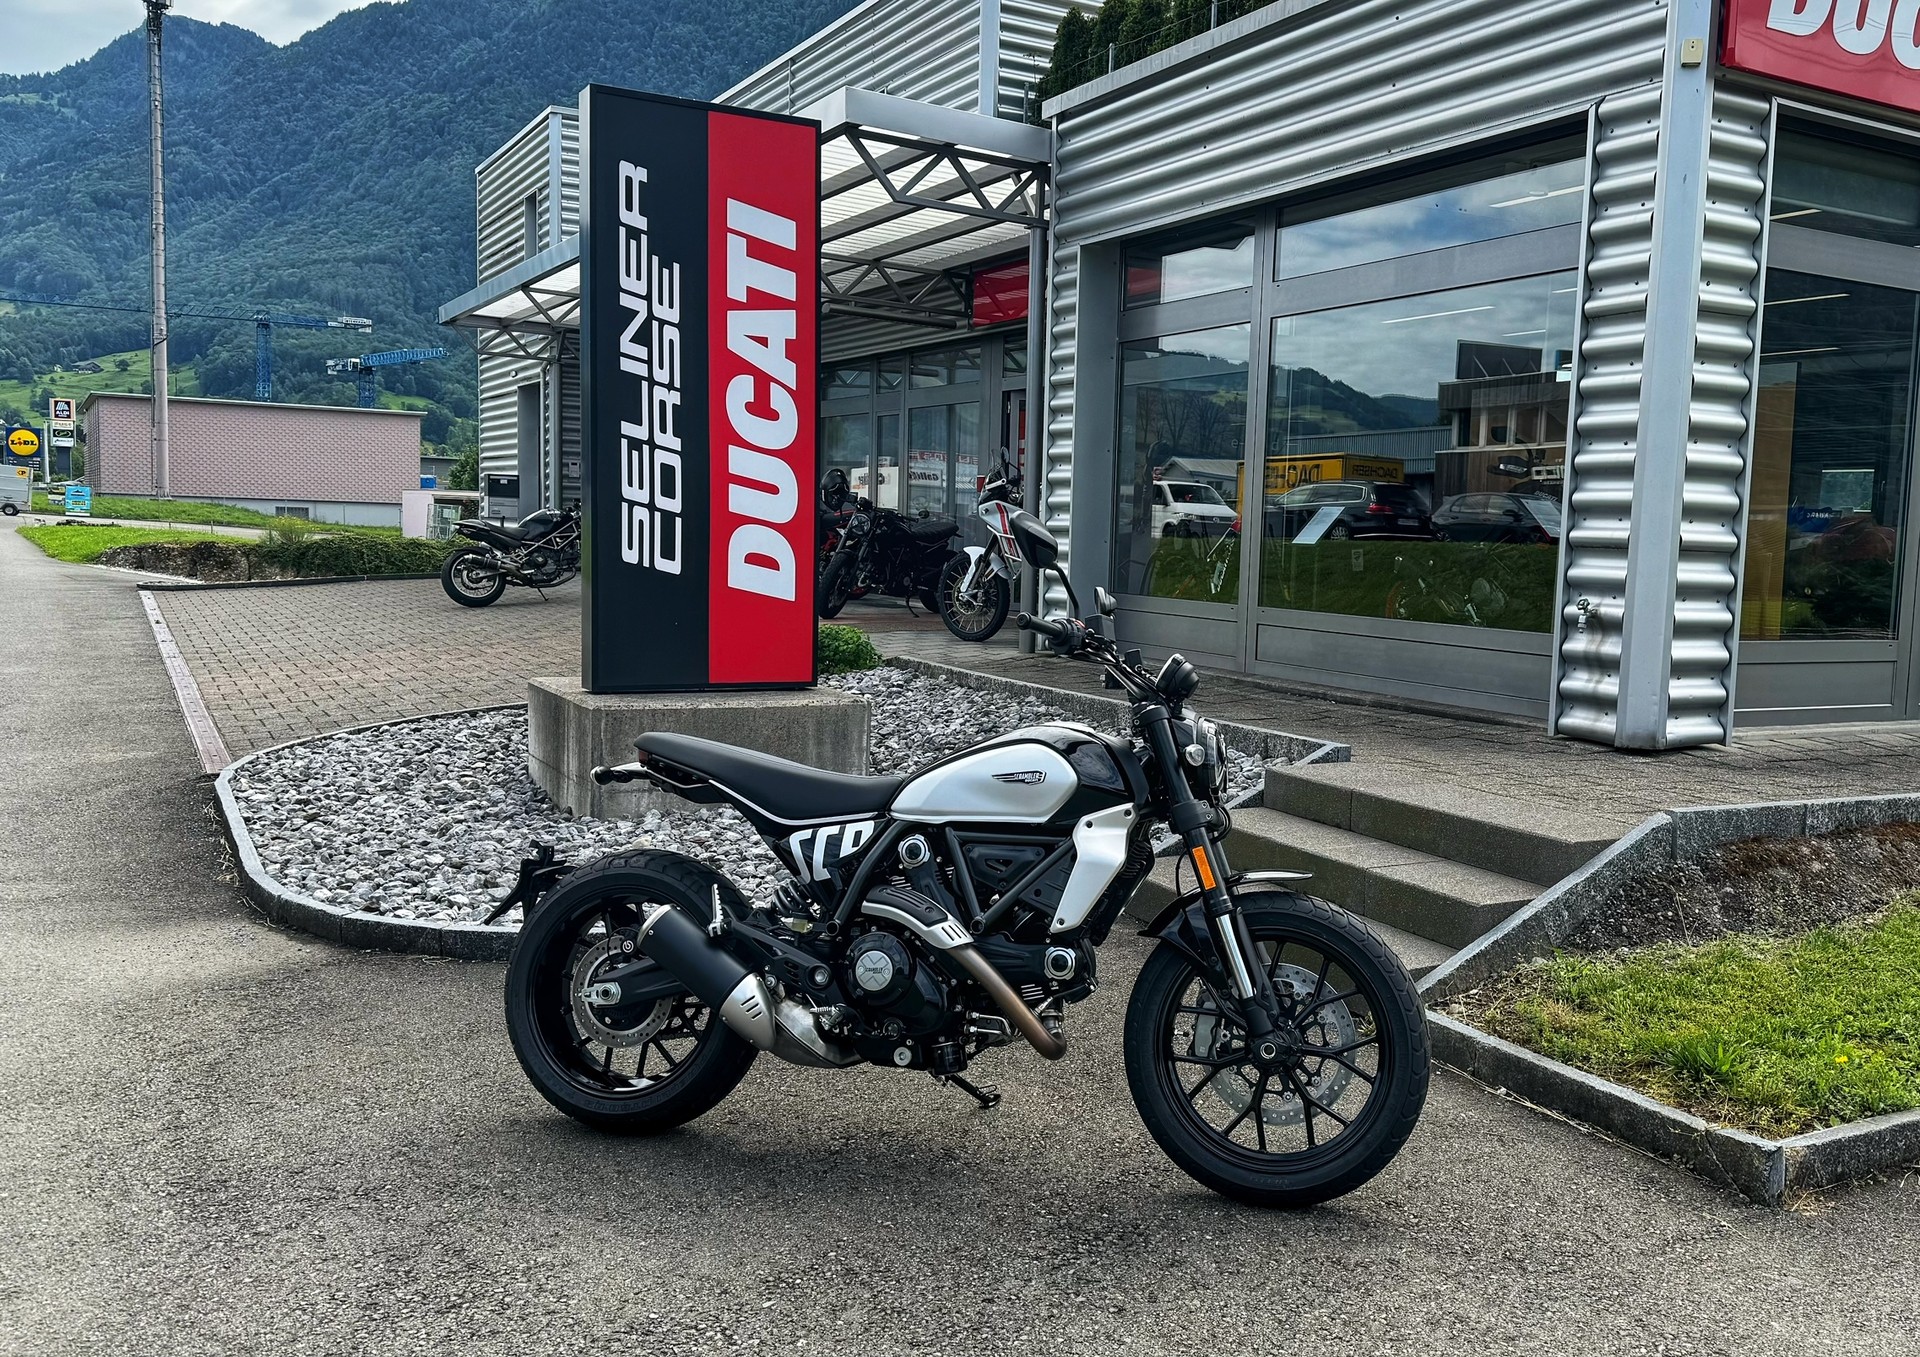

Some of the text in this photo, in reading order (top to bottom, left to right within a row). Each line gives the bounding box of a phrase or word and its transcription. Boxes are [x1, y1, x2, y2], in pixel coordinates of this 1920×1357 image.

[618, 160, 650, 568] SELINER
[651, 254, 682, 575] CORSE
[726, 197, 799, 602] DUCATI
